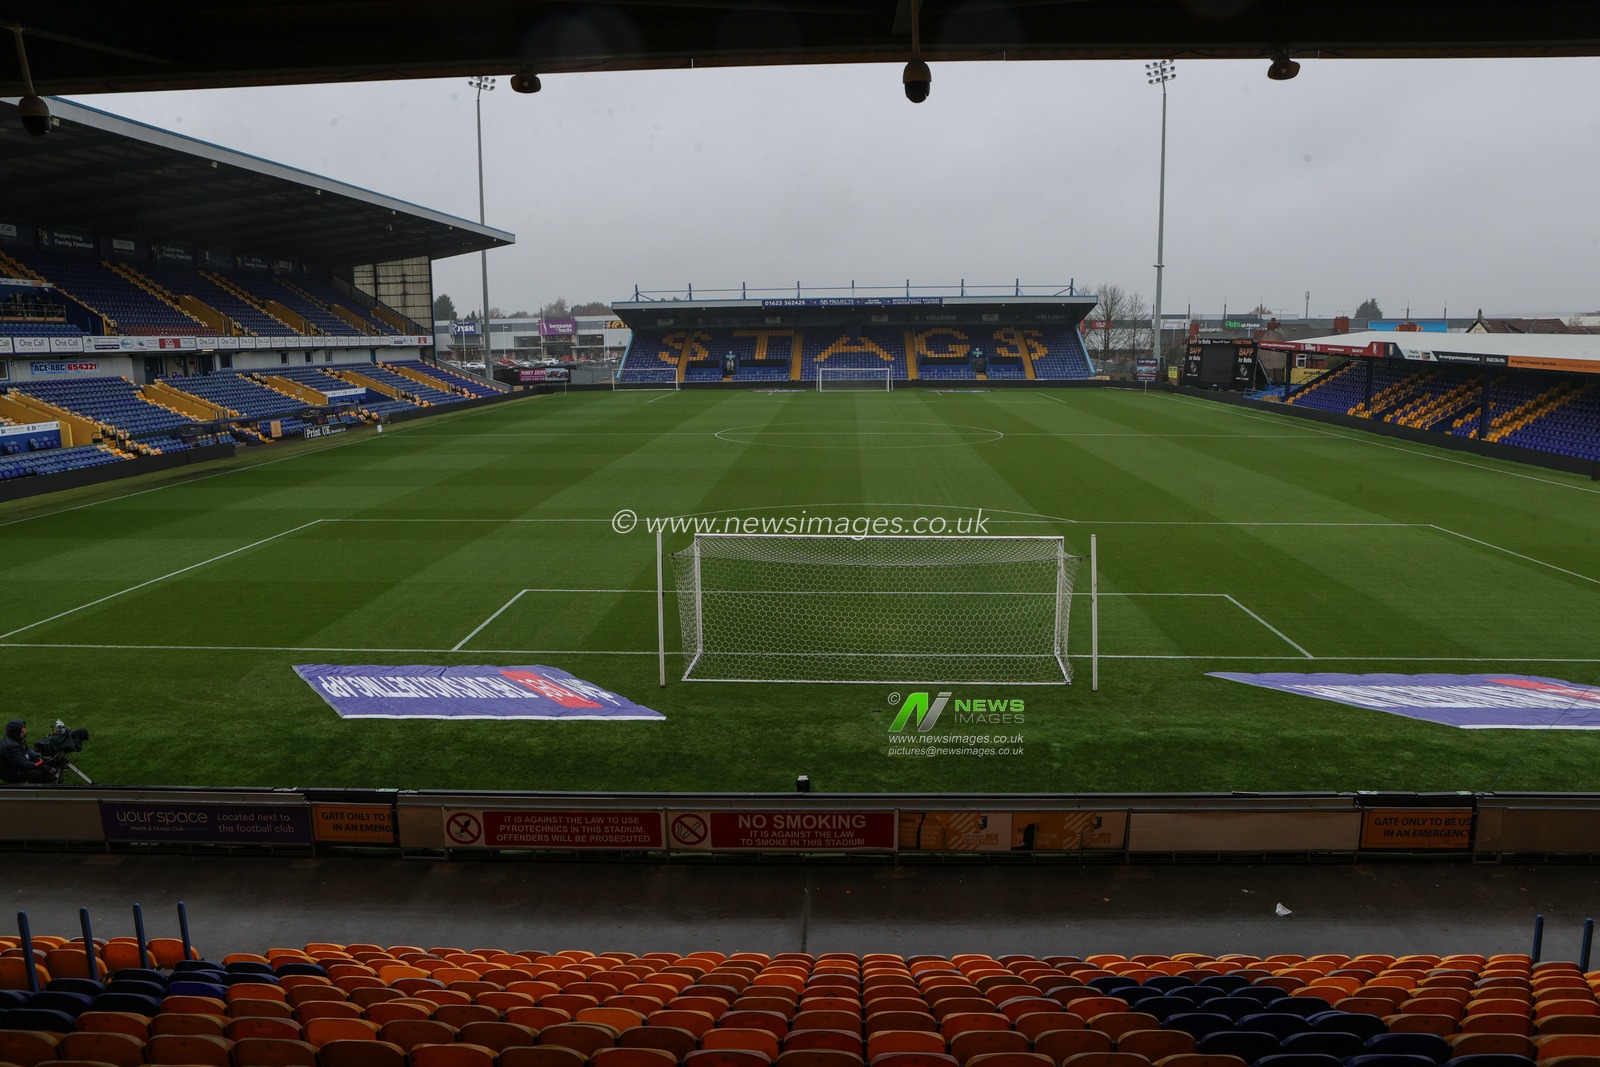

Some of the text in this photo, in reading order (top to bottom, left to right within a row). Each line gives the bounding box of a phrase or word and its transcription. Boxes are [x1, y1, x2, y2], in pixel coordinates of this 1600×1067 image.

[19, 339, 45, 347] One Call
[55, 338, 79, 347] One Call
[1239, 348, 1254, 357] BAPP
[34, 363, 97, 372] ACE-ABC 654321
[307, 426, 331, 438] Print UK
[217, 812, 290, 822] Located next to
[322, 811, 385, 821] GATE ONLY TO
[504, 815, 512, 823] IT
[514, 815, 522, 823] IS
[565, 816, 583, 824] THE
[585, 816, 605, 824] LAW
[738, 814, 866, 830] NO SMOKING
[1374, 817, 1472, 826] GATE ONLY TO BE US
[219, 825, 294, 834] the football club
[333, 823, 392, 833] IN AN EMERG
[499, 824, 646, 834] PYROTECHNICS IN THIS STADIUM.
[771, 831, 811, 839] AGAINST
[814, 831, 831, 839] THE
[834, 831, 855, 839] LAW
[1384, 829, 1393, 837] IN
[1396, 829, 1410, 837] AN
[496, 834, 651, 843] OFFENDERS WILL BE PROSECUTED
[740, 838, 865, 847] TO SMOKE IN THIS STADIUM
